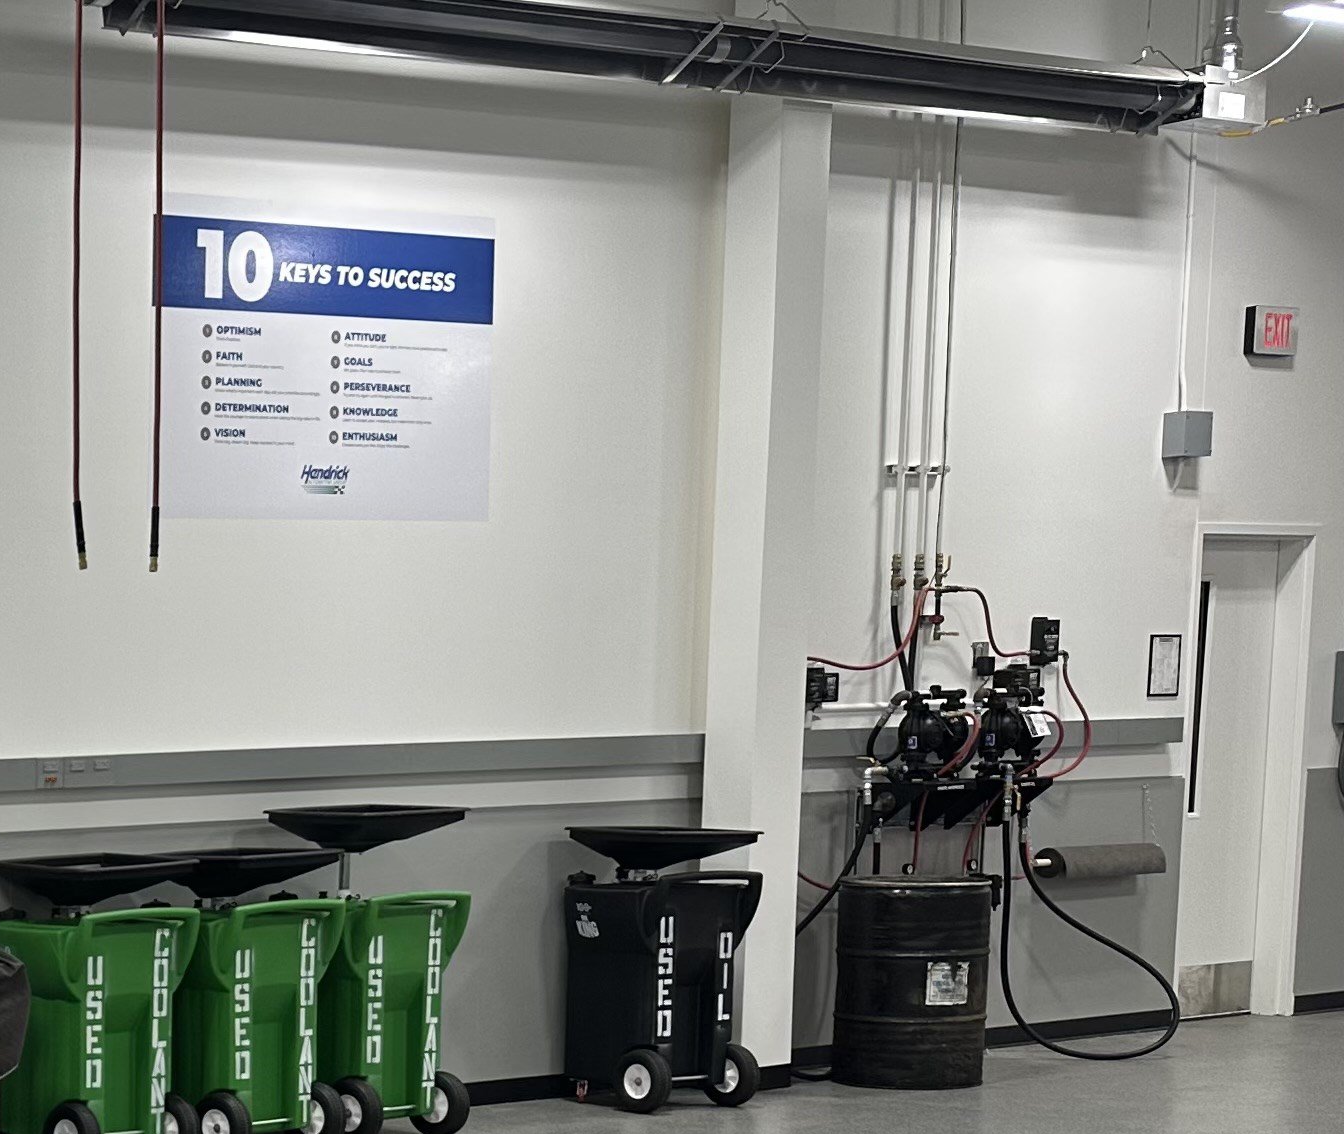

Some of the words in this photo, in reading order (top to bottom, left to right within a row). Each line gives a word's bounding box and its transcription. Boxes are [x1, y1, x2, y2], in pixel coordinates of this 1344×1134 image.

[197, 228, 274, 302] 10
[279, 261, 332, 285] KEYS
[337, 265, 364, 286] TO
[368, 268, 457, 293] SUCCESS
[216, 325, 262, 336] OPTIMISM
[344, 332, 387, 343] ATTITUDE
[1264, 312, 1293, 348] EXIT
[216, 351, 243, 361] FAITH
[344, 357, 373, 367] GOALS
[215, 377, 263, 388] PLANNING
[343, 382, 411, 393] PERSEVERANCE
[214, 402, 290, 414] DETERMINATION
[342, 407, 399, 418] KNOWLEDGE
[214, 428, 246, 438] VISION
[342, 432, 398, 442] ENTHUSIASM
[300, 464, 350, 484] Hendrick
[656, 916, 675, 1037] USED
[717, 931, 733, 1021] OIL
[366, 935, 384, 1064] USED
[234, 949, 251, 1080] USED
[421, 908, 444, 1109] COOLANT
[85, 955, 103, 1089] USED
[298, 918, 316, 1124] COOLANT
